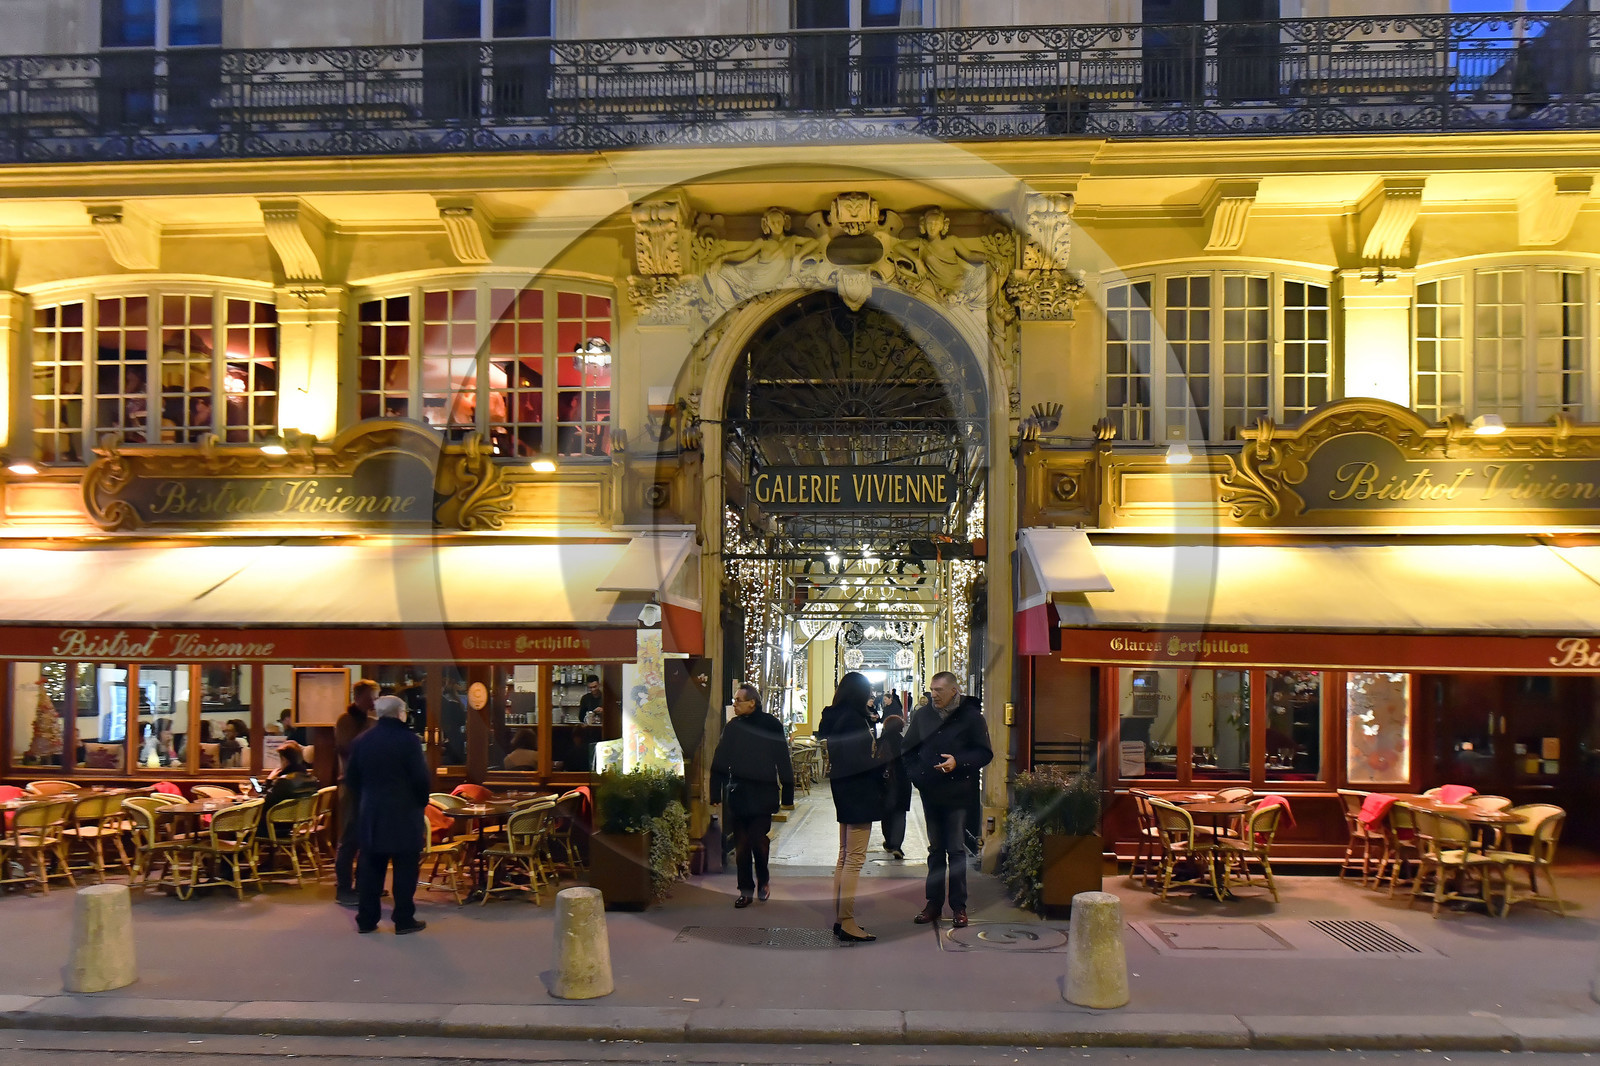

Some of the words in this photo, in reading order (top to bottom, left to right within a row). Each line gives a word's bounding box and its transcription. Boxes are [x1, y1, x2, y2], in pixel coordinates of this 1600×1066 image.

[755, 473, 841, 503] GALERIE
[852, 474, 948, 503] VIVIENNE
[1329, 461, 1474, 500] Bistrot
[149, 481, 274, 514] Bistrot
[278, 480, 416, 513] Vivienne
[54, 629, 161, 656] Bistrot
[1109, 637, 1162, 652] Glaces
